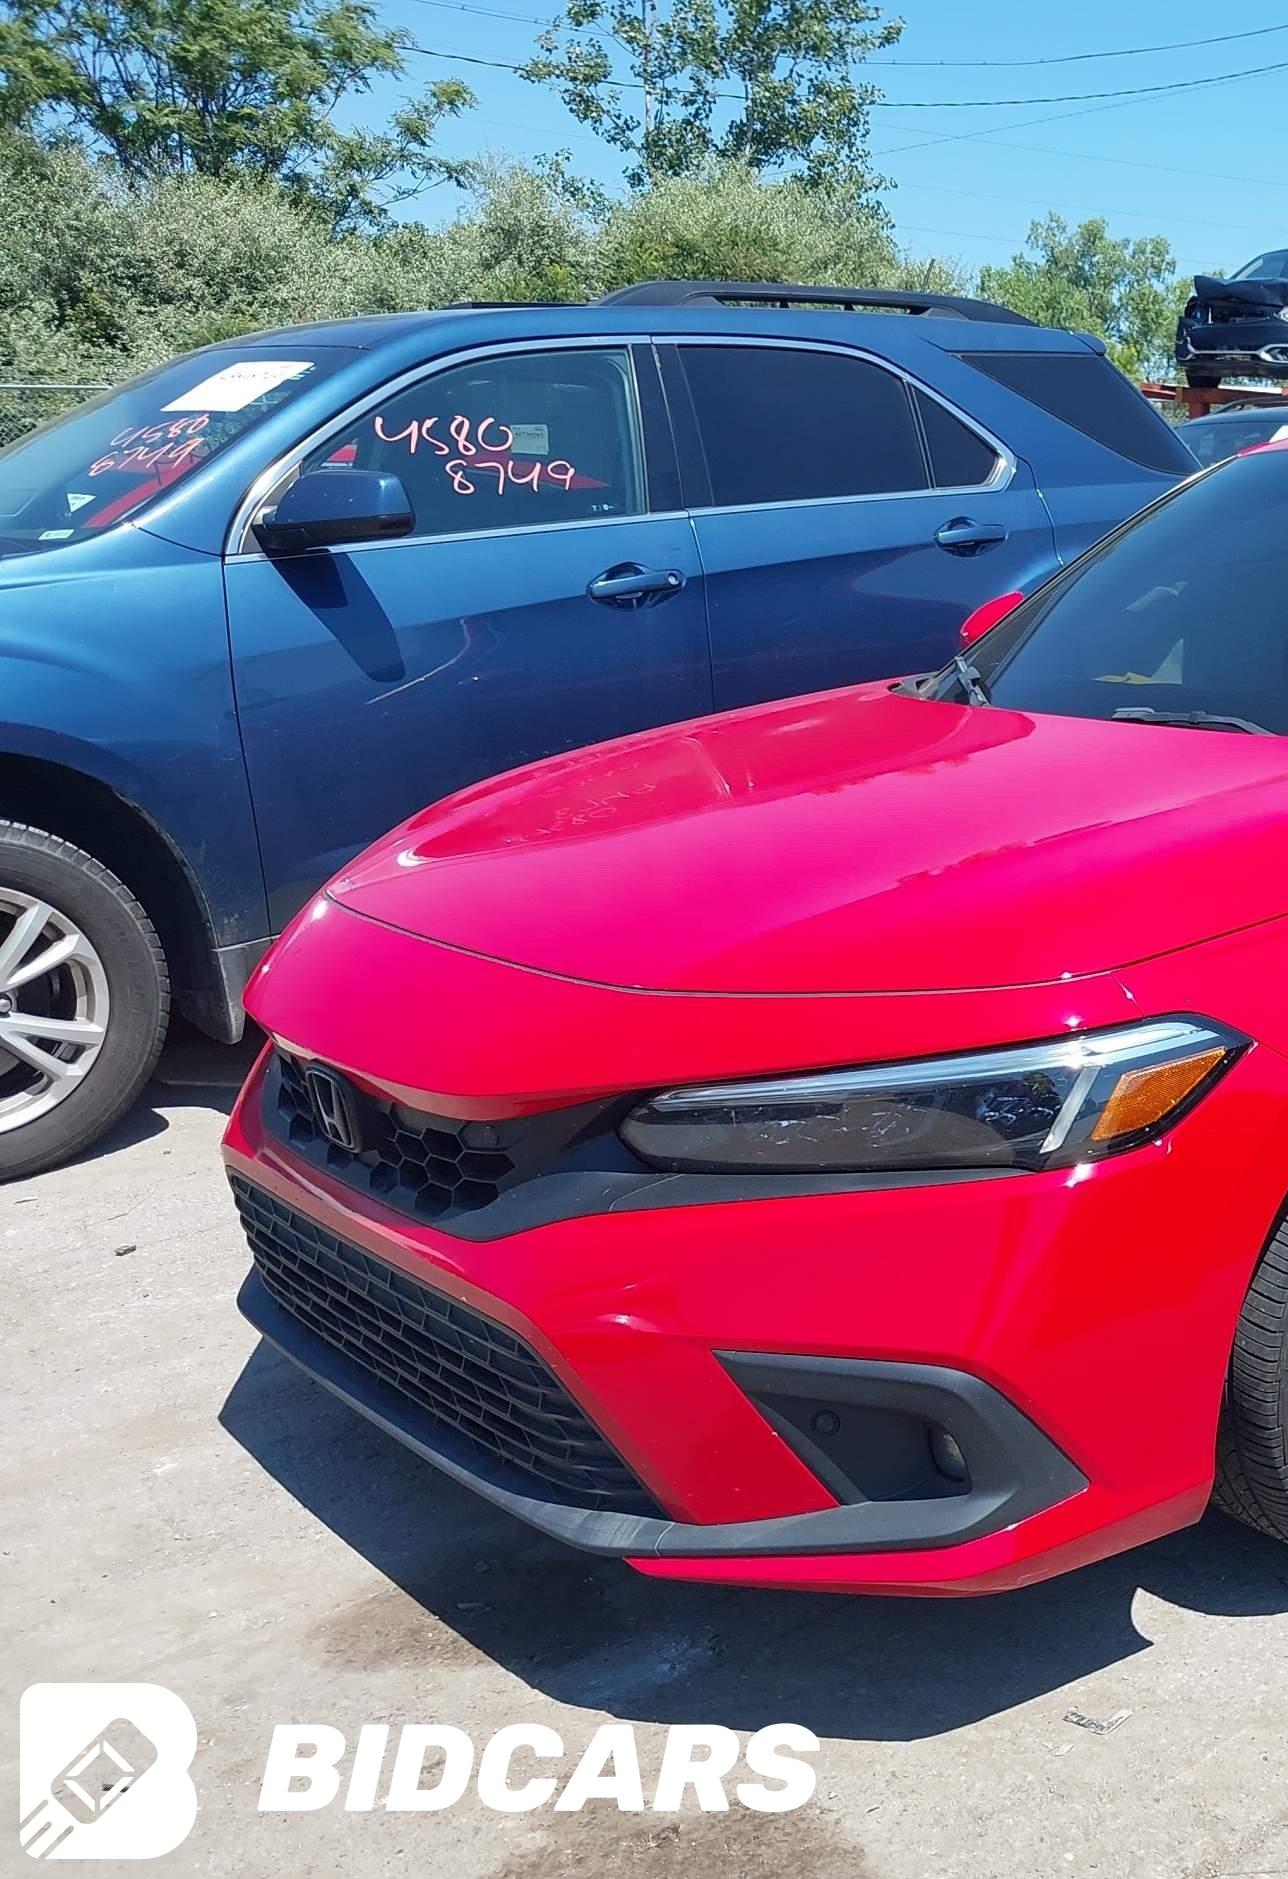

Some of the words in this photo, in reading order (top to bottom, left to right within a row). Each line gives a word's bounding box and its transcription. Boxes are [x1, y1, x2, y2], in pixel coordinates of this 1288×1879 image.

[110, 413, 210, 447] 4580
[374, 415, 513, 456] 4580
[88, 438, 205, 477] 8749
[445, 459, 576, 495] 8749
